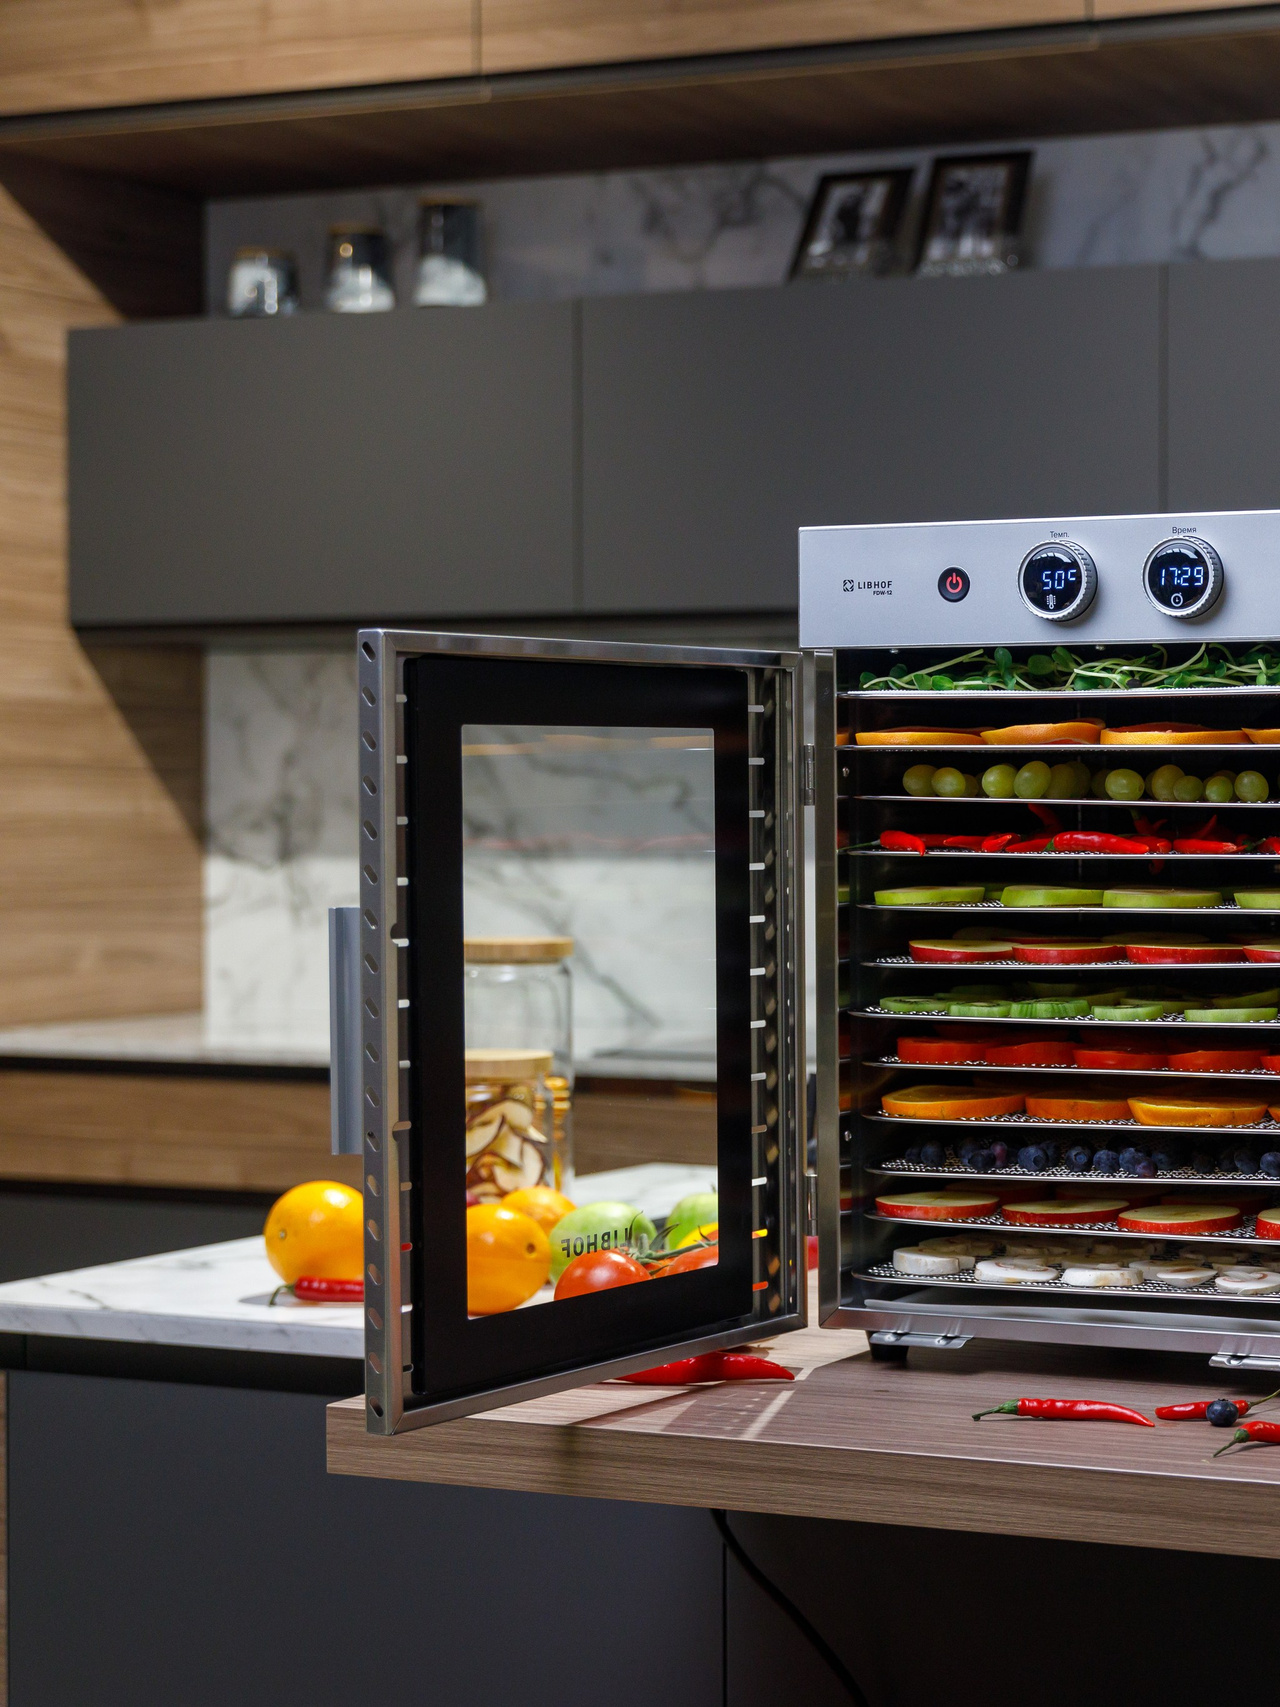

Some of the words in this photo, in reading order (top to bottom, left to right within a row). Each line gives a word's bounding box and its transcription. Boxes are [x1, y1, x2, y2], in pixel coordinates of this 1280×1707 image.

[1049, 530, 1070, 538] Темп.
[1171, 526, 1197, 535] Время
[1161, 566, 1204, 586] 17:29
[857, 580, 893, 590] LIBHOF
